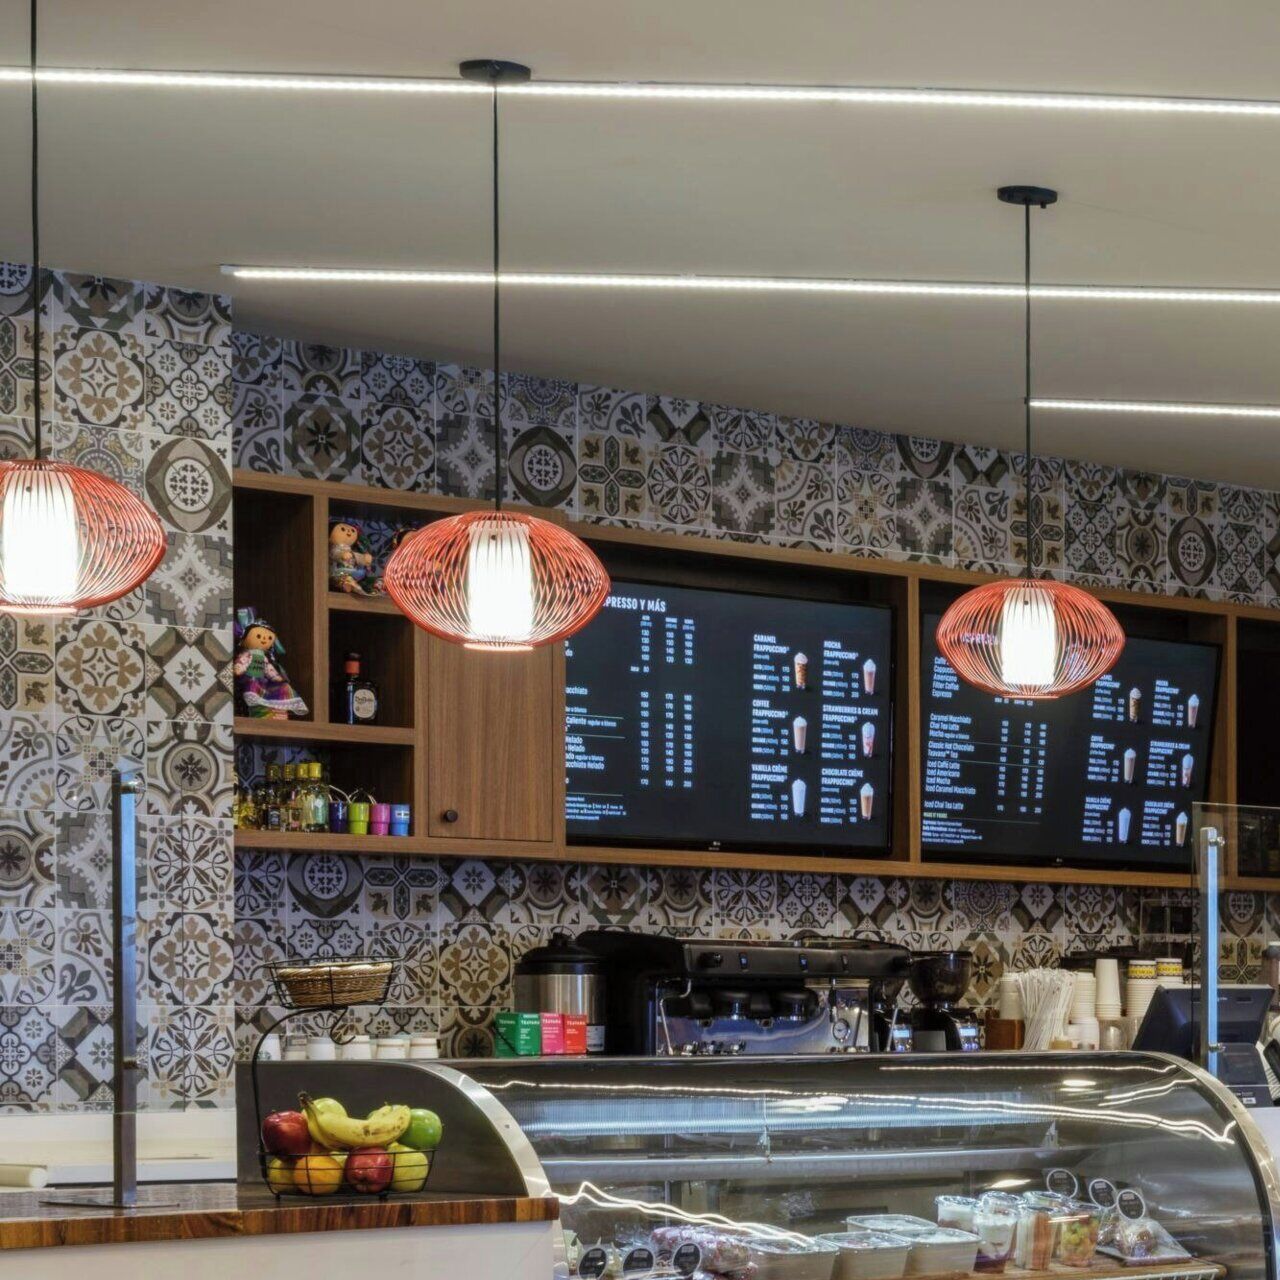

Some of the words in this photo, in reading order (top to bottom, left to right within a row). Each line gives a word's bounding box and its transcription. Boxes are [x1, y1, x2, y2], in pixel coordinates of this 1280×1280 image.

[602, 596, 638, 610] PRESSO
[640, 599, 646, 610] Y
[647, 598, 666, 612] MÁS
[565, 687, 588, 695] acchiato
